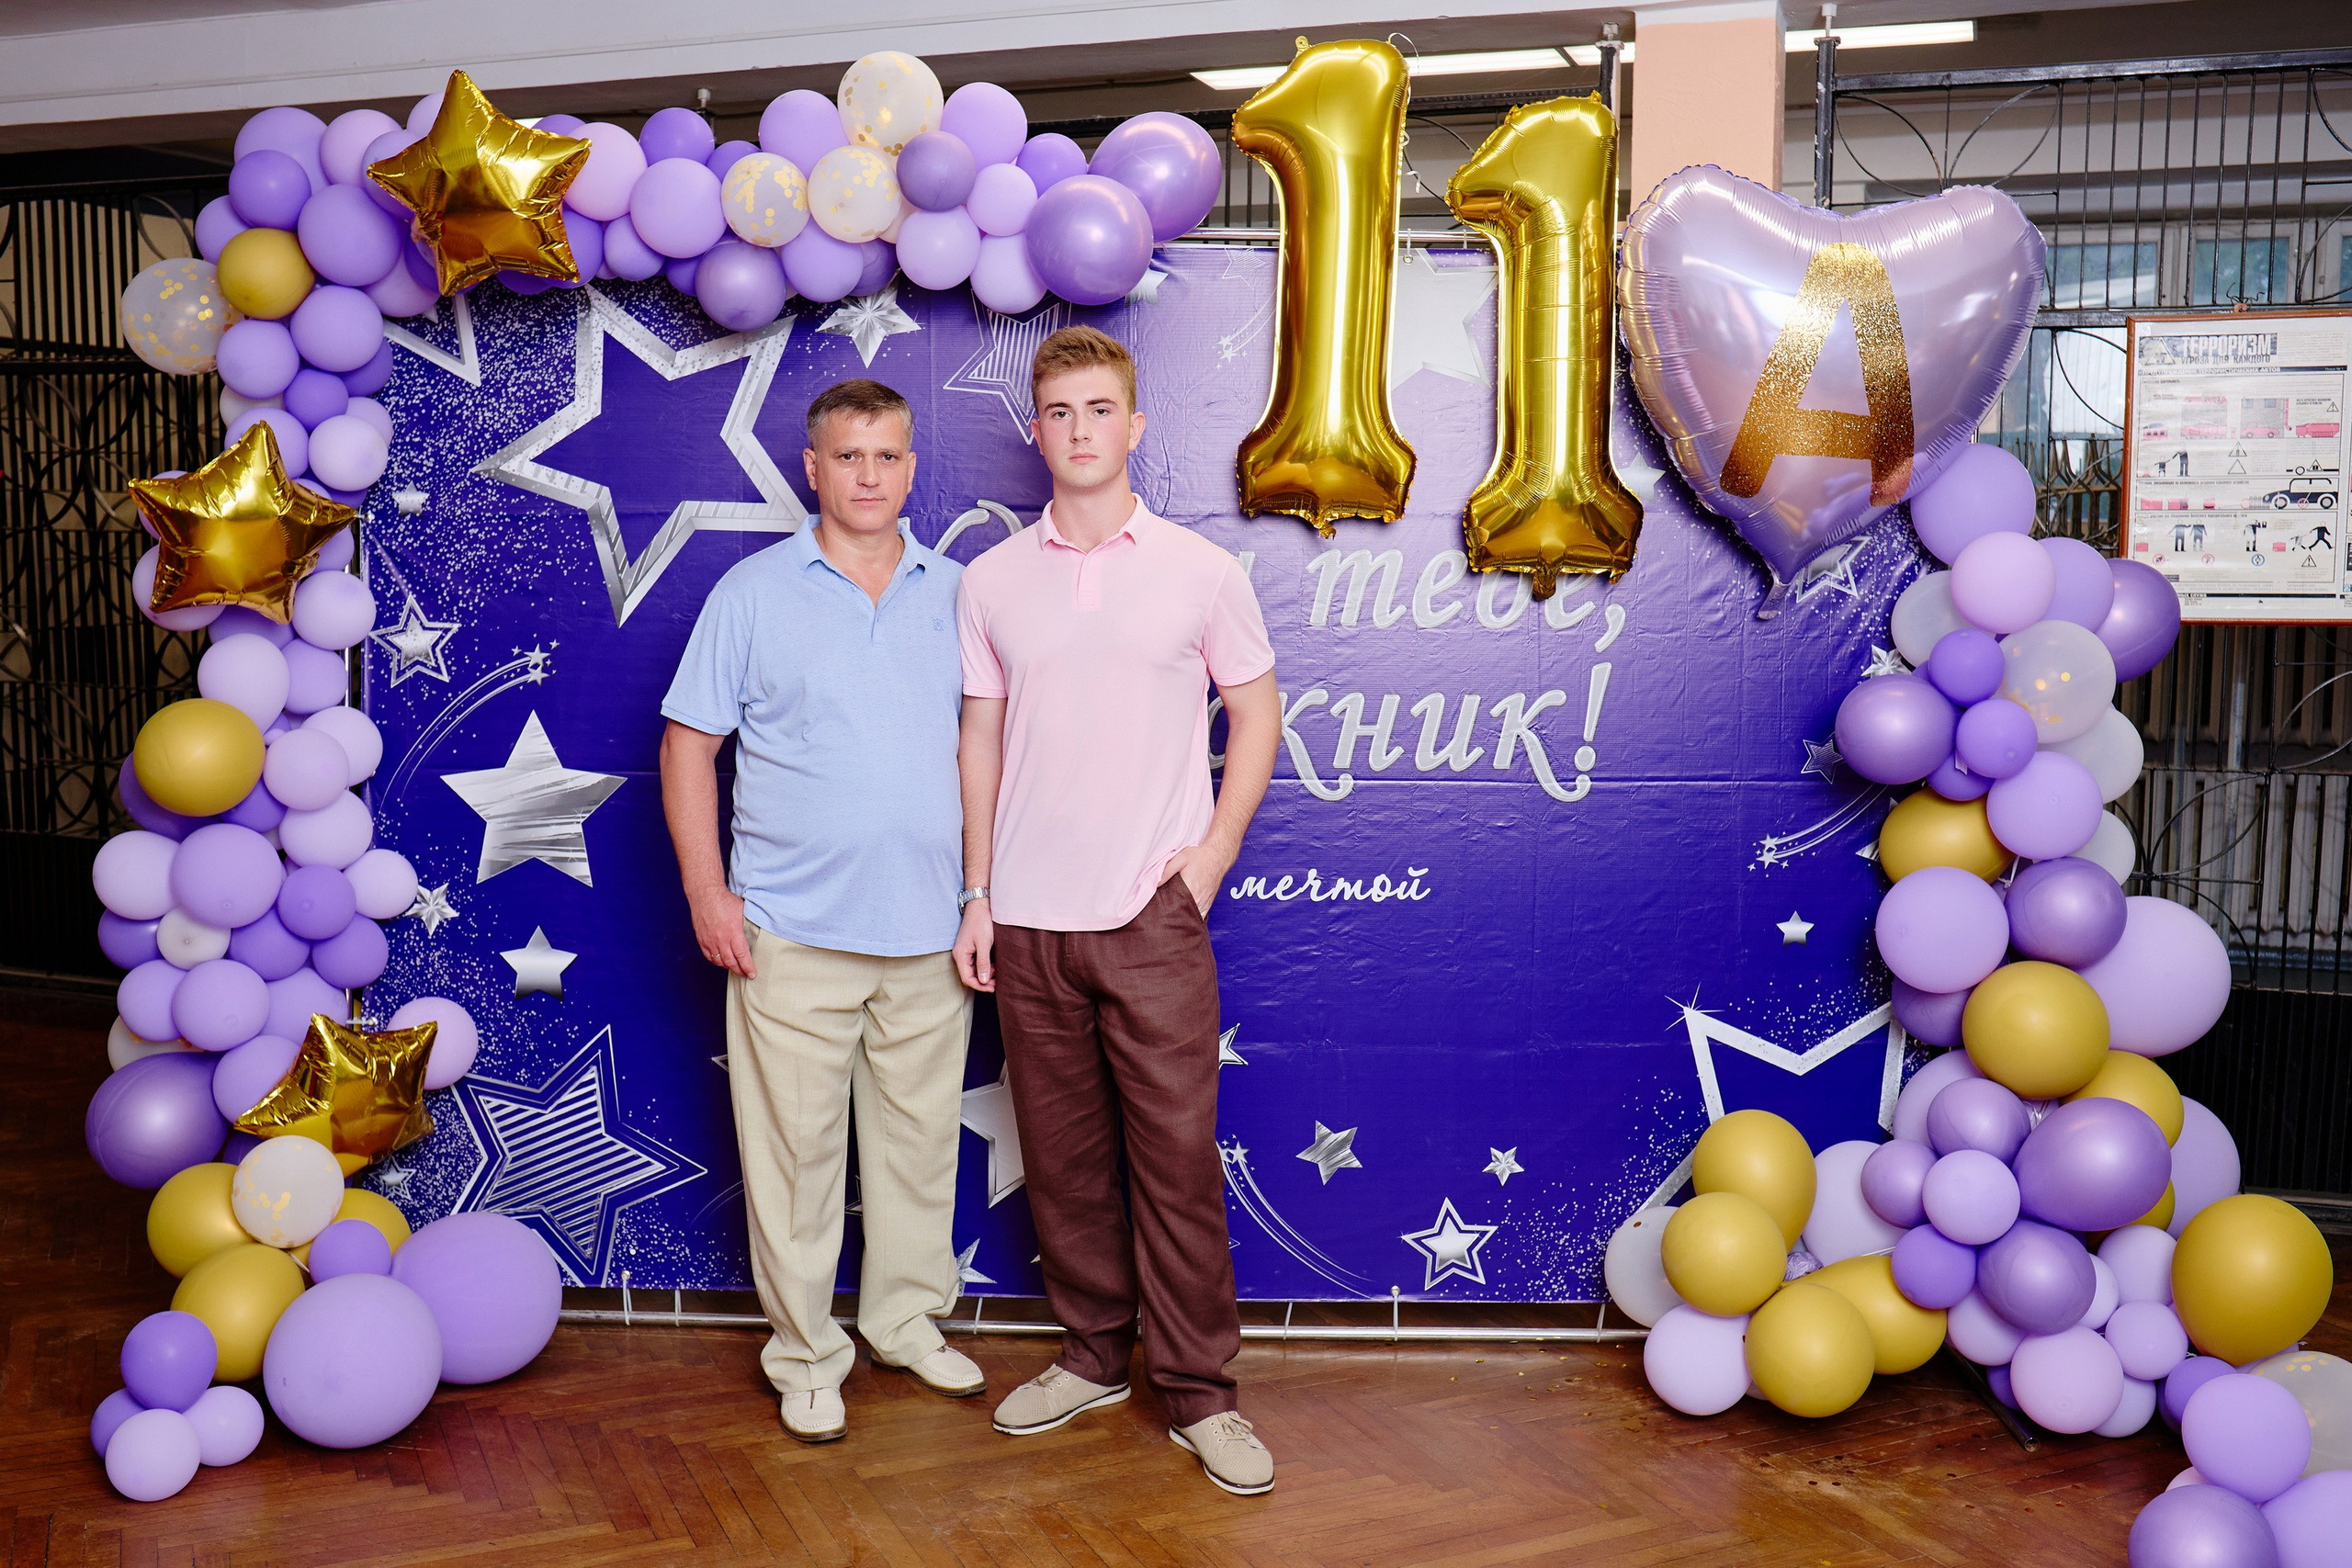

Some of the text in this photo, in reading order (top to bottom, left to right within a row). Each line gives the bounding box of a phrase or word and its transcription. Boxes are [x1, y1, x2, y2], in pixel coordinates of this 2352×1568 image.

[2181, 334, 2270, 356] ТЕРРОРИЗМ
[2181, 355, 2270, 366] УГРОЗА ДЛЯ КАЖДОГО
[1229, 866, 1430, 902] мечтой
